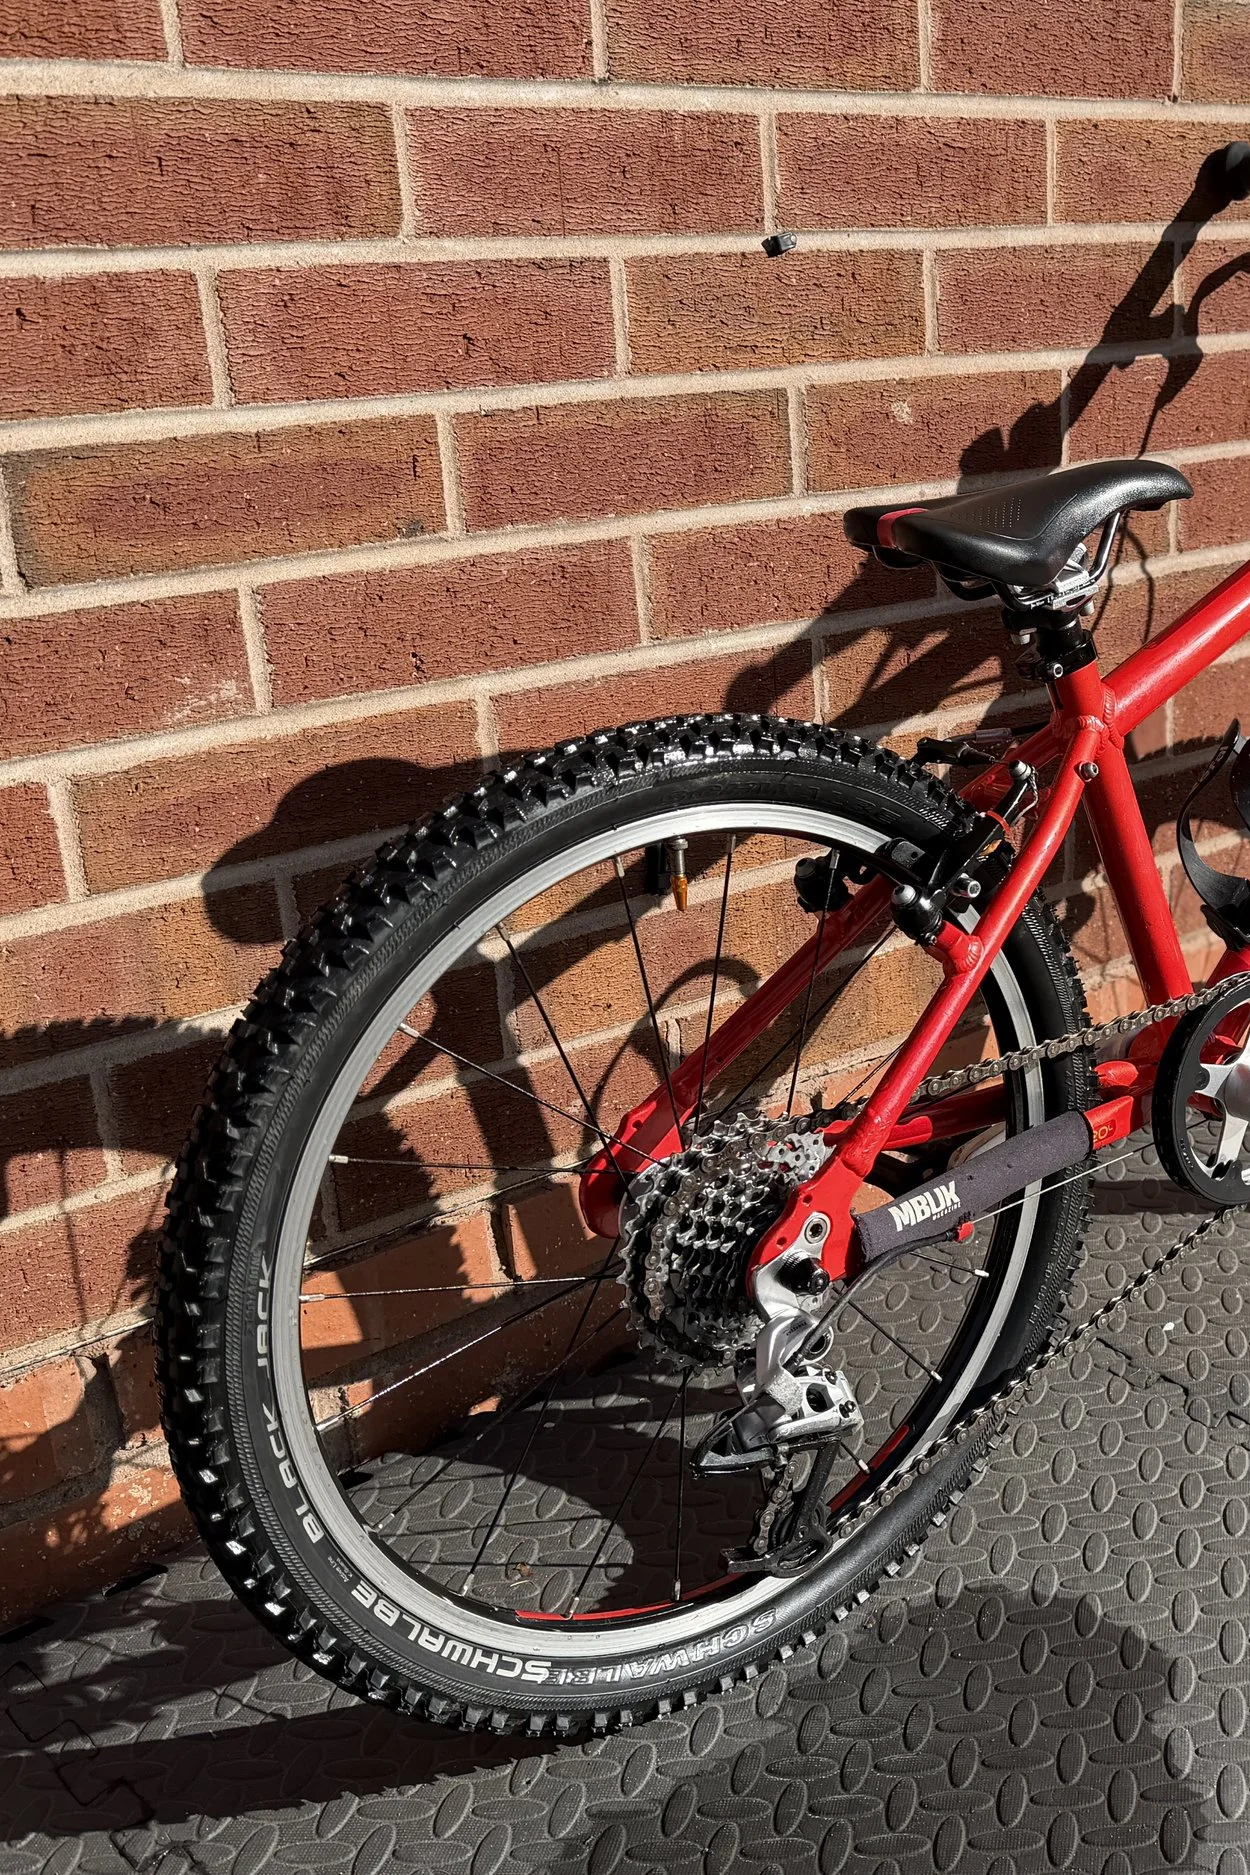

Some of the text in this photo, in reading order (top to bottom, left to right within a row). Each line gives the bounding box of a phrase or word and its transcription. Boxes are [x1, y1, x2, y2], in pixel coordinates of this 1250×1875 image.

[888, 1180, 960, 1232] MBUK
[257, 1255, 324, 1544] BLACK JACK
[350, 1577, 552, 1683] SCHWALBE
[548, 1607, 779, 1686] SCHWALBE
